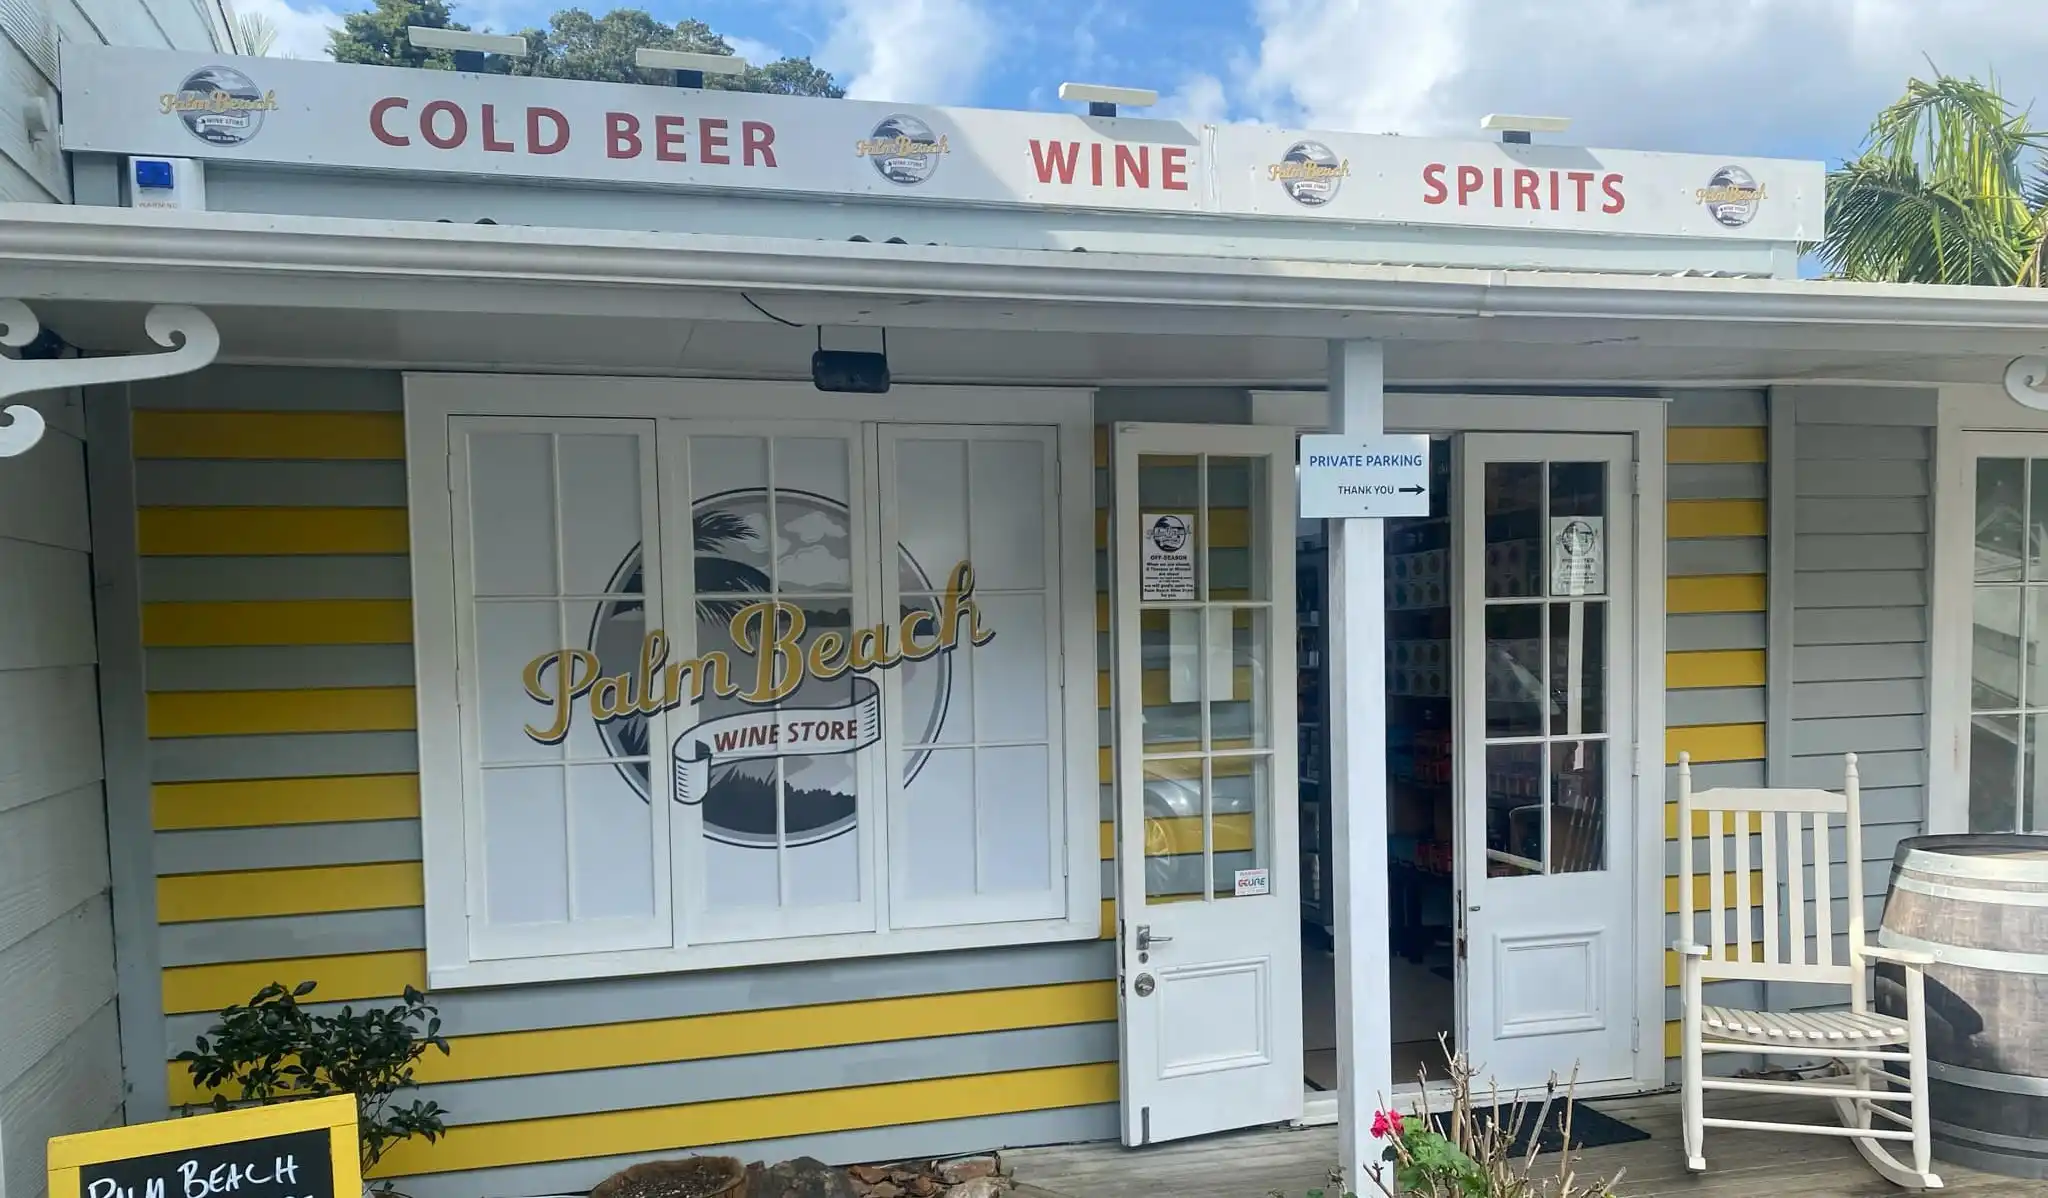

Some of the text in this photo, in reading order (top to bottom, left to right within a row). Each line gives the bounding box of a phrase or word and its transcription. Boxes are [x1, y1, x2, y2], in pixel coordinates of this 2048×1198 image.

[210, 89, 280, 114] Beach
[369, 96, 779, 169] COLD BEER
[1028, 139, 1189, 191] WINE
[1423, 163, 1626, 215] SPIRITS
[1309, 454, 1423, 467] PRIVATE PARKING
[1338, 485, 1395, 495] THANK YOU
[522, 560, 996, 746] Palm Beach
[713, 718, 859, 753] WINE STORE
[177, 1154, 299, 1198] BEACH
